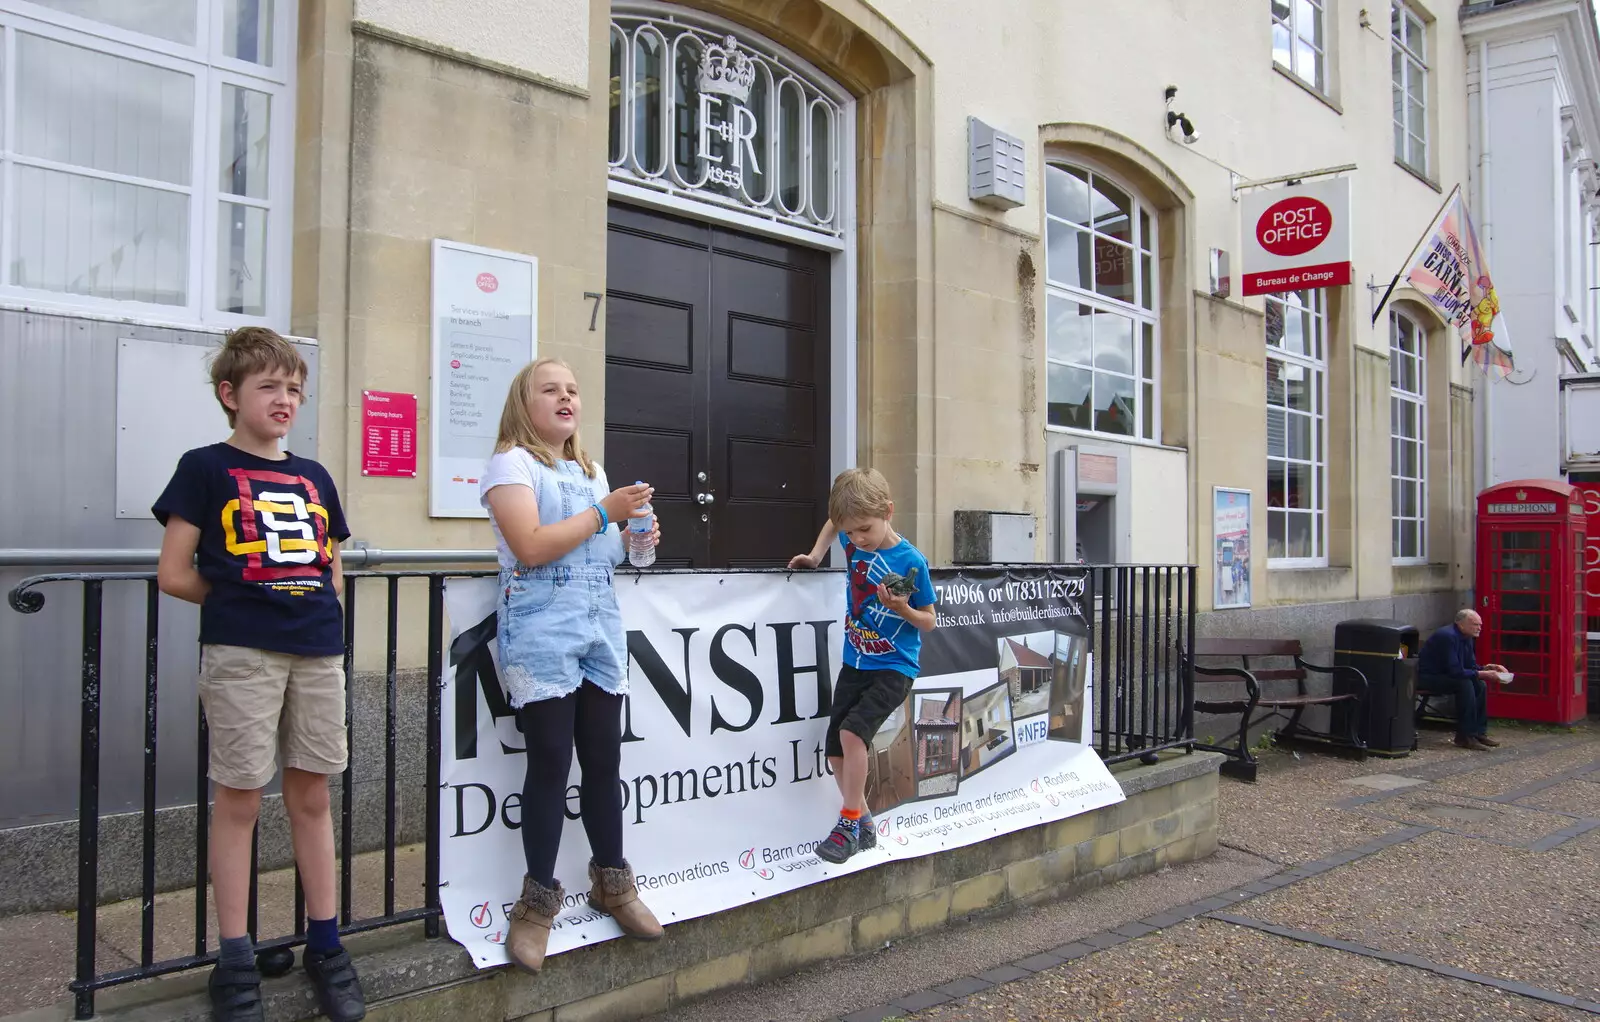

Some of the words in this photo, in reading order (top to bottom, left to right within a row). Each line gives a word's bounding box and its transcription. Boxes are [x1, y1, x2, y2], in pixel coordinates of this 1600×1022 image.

[1273, 207, 1317, 227] POST
[1263, 222, 1323, 244] OFFICE
[1256, 276, 1287, 287] Bureau
[1289, 274, 1300, 283] de
[1302, 270, 1334, 282] Change
[450, 304, 479, 316] Services
[584, 291, 604, 331] 7
[459, 318, 482, 327] branch
[367, 409, 387, 419] Opening
[388, 411, 403, 419] hours
[1491, 503, 1554, 513] TELEPHONE
[935, 583, 985, 605] 740966
[988, 585, 1003, 603] or
[1025, 720, 1047, 742] NFB
[636, 860, 730, 892] Renovations
[762, 846, 793, 864] Barn
[934, 802, 974, 821] Decking
[975, 794, 992, 810] and
[1043, 771, 1080, 787] Roofing
